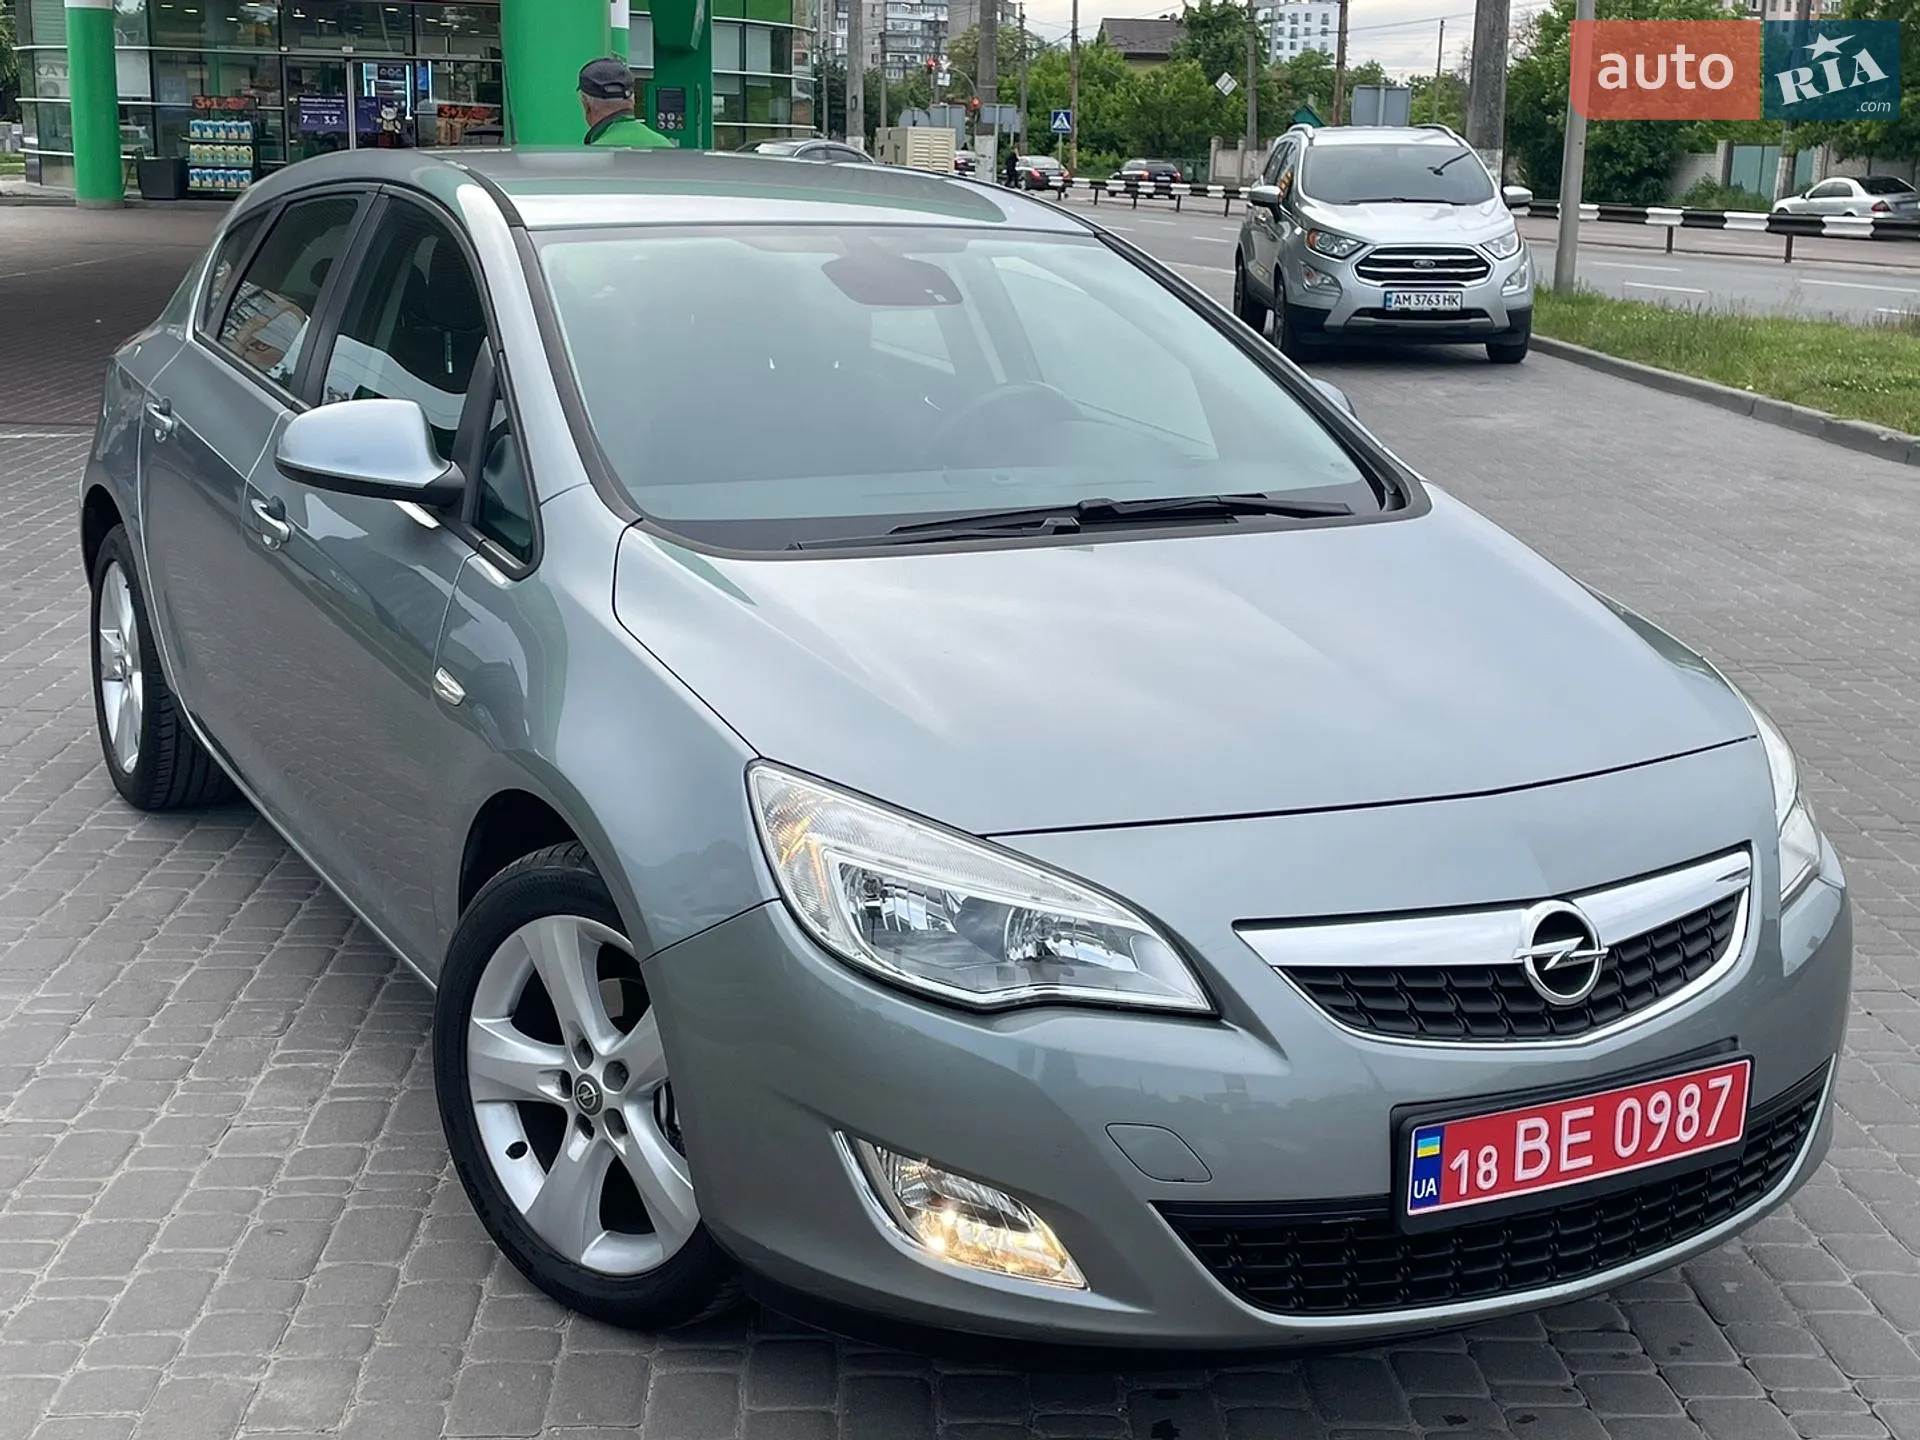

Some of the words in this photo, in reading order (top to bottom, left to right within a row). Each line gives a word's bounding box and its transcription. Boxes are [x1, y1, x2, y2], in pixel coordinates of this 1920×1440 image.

[1393, 294, 1412, 306] AM
[1414, 294, 1441, 306] 3763
[1442, 294, 1459, 306] HK
[1449, 1145, 1498, 1196] 18
[1513, 1106, 1596, 1184] BE
[1613, 1074, 1734, 1159] 0987
[1413, 1177, 1439, 1199] UA
